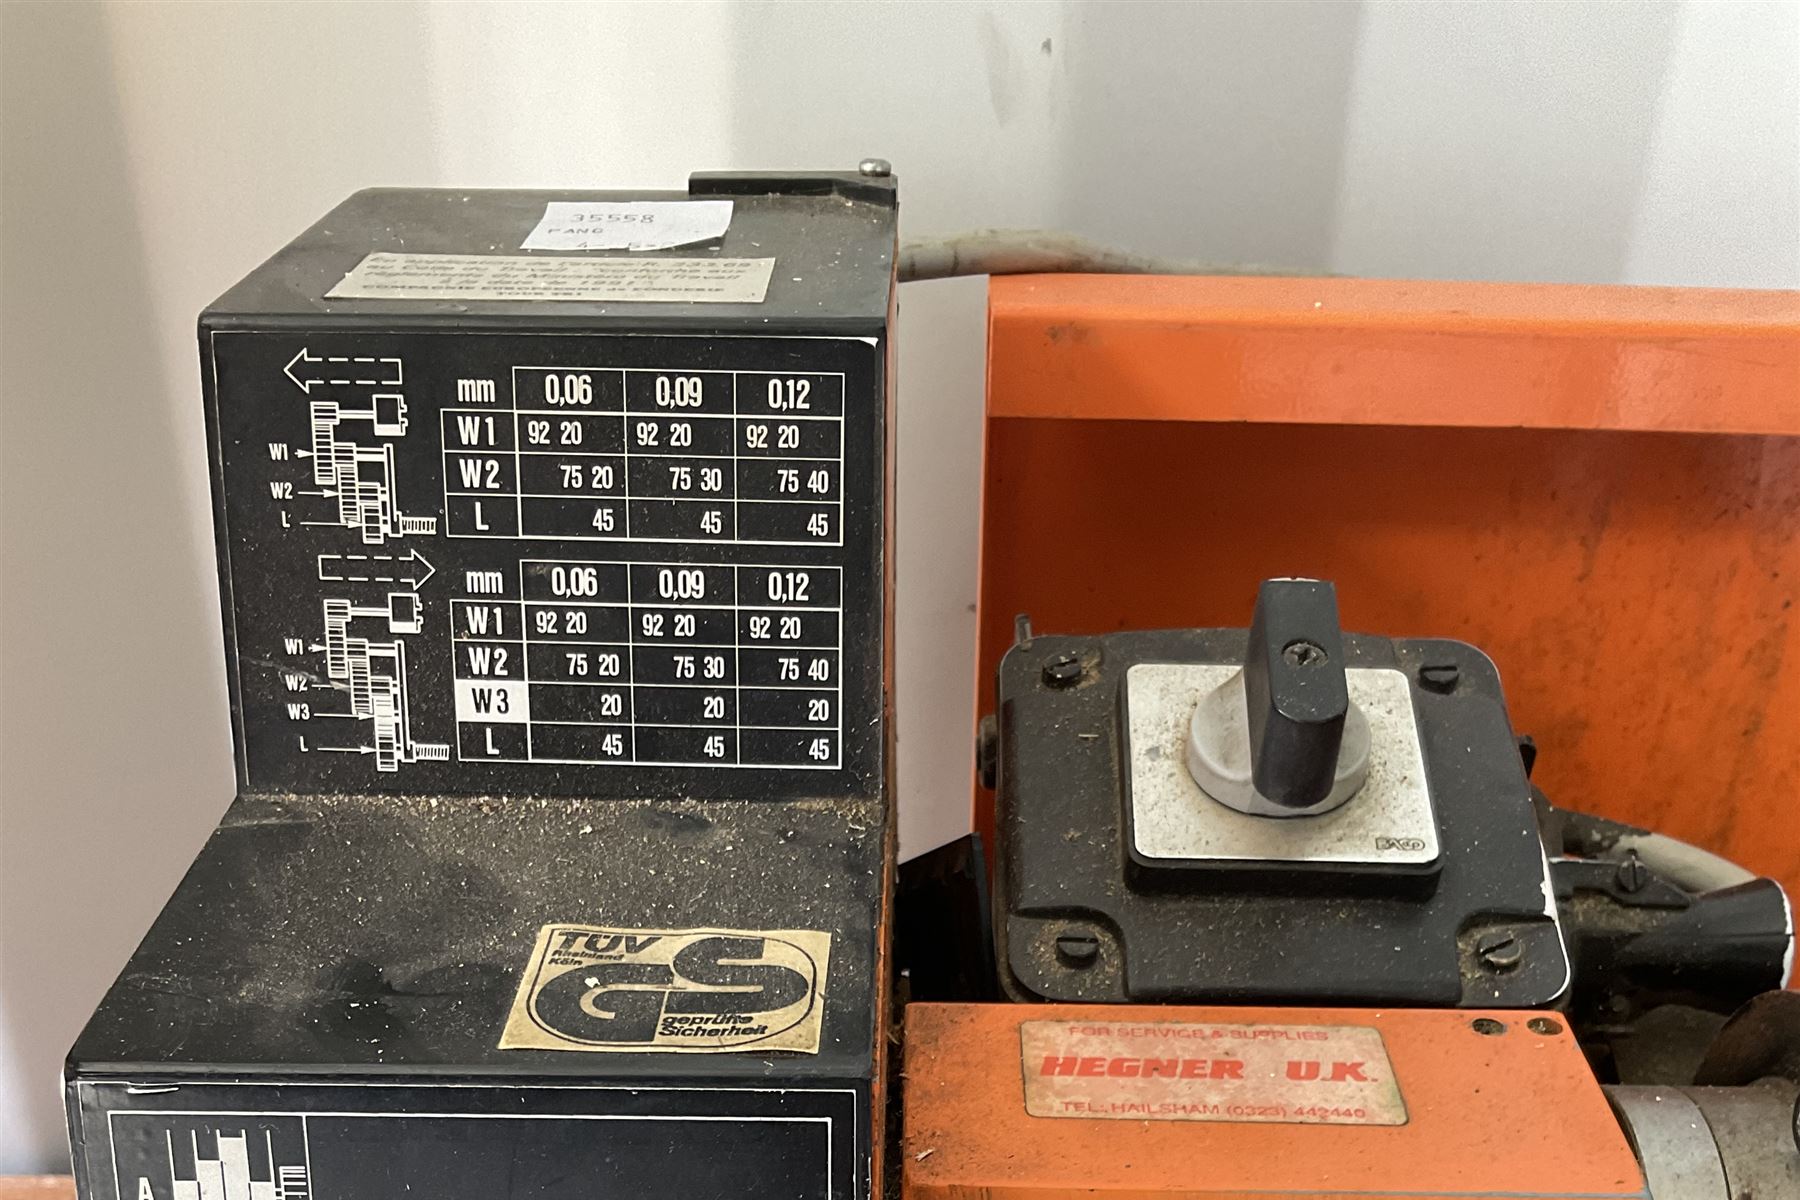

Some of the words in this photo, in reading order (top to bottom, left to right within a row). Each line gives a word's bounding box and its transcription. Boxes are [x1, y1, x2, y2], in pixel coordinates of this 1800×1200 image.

[457, 379, 496, 403] mm
[544, 373, 593, 407] 0,06
[655, 376, 703, 410] 0,09
[768, 378, 811, 412] 0,12
[527, 420, 551, 445] 92
[560, 421, 583, 445] 20
[636, 421, 659, 446] 92
[669, 422, 692, 447] 20
[746, 424, 768, 449] 92
[777, 424, 800, 449] 20
[268, 442, 289, 461] W1
[269, 481, 294, 500] W2
[559, 464, 583, 489] 75
[591, 465, 614, 490] 20
[669, 466, 692, 491] 75
[700, 467, 722, 492] 30
[777, 469, 799, 493] 75
[806, 470, 829, 494] 40
[281, 510, 291, 528] L
[474, 501, 490, 531] L
[592, 508, 614, 532] 45
[700, 510, 722, 534] 45
[806, 513, 829, 537] 45
[466, 571, 504, 594] mm
[551, 566, 598, 599] 0,06
[658, 569, 705, 601] 0,09
[768, 571, 810, 604] 0,12
[600, 693, 622, 716] 20
[703, 696, 725, 719] 20
[808, 698, 829, 722] 20
[485, 727, 500, 755] L
[601, 733, 623, 756] 45
[703, 735, 725, 758] 45
[808, 738, 830, 761] 45
[557, 931, 662, 952] TÜV
[548, 958, 583, 966] Köln
[659, 1024, 768, 1037] Sicherheit
[1069, 1028, 1111, 1037] FOR
[1118, 1028, 1201, 1039] SERVICE
[1230, 1030, 1329, 1041] SUPPLIES
[1040, 1057, 1245, 1080] HEGNER
[1285, 1061, 1379, 1083] U.K.
[1112, 1104, 1219, 1116] HAILSHAM
